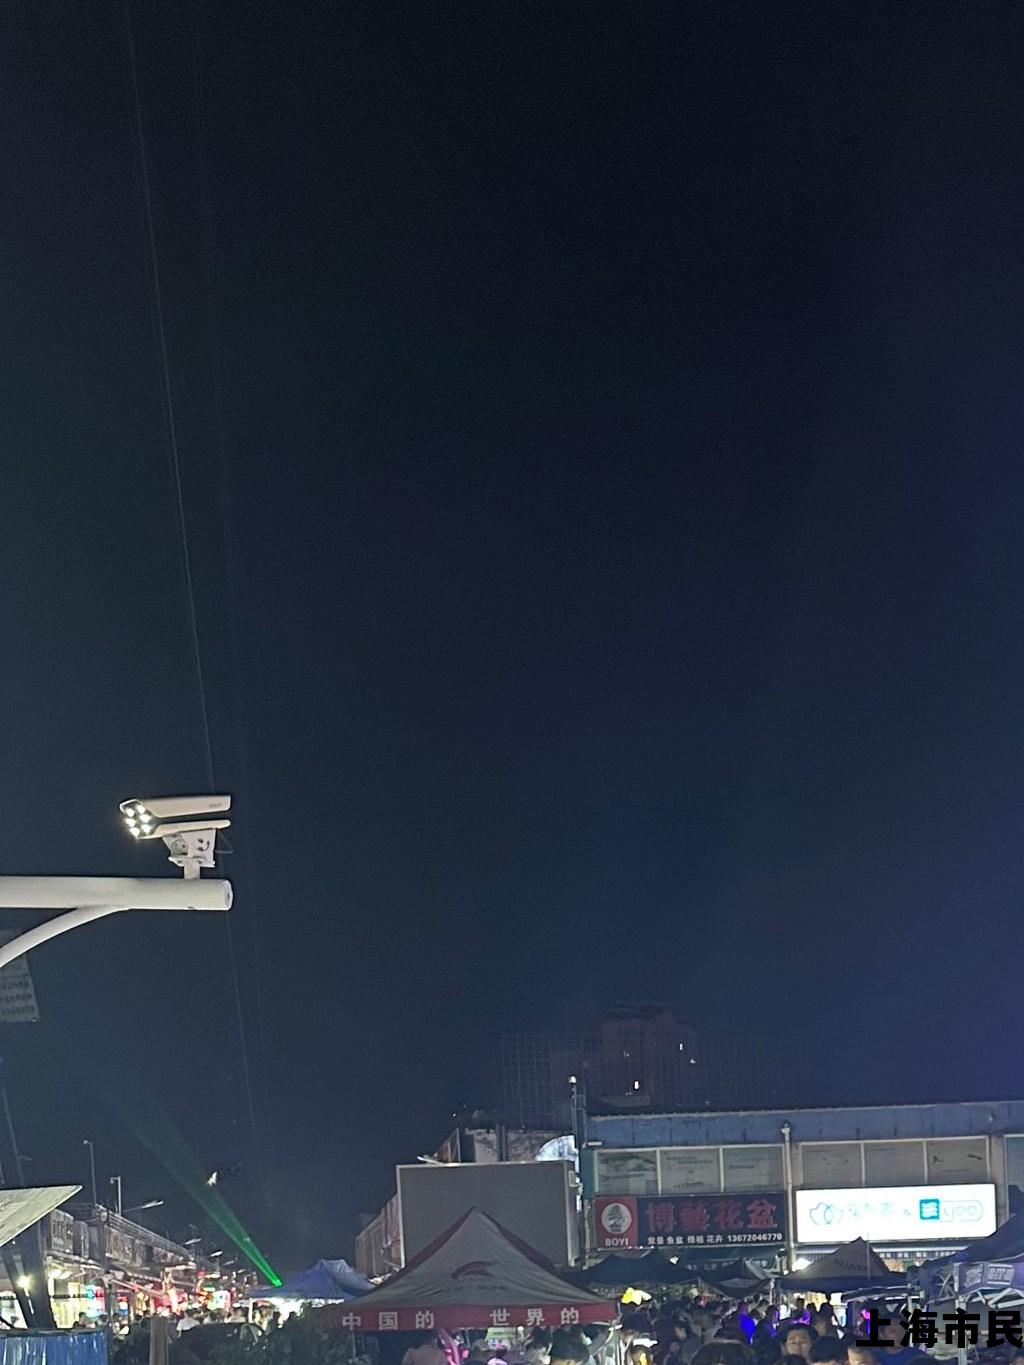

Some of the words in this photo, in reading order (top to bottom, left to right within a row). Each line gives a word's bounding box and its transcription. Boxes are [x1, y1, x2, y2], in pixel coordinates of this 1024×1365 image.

[605, 1237, 629, 1247] BOYI
[341, 1310, 435, 1331] 中国的
[489, 1307, 579, 1327] 世界的
